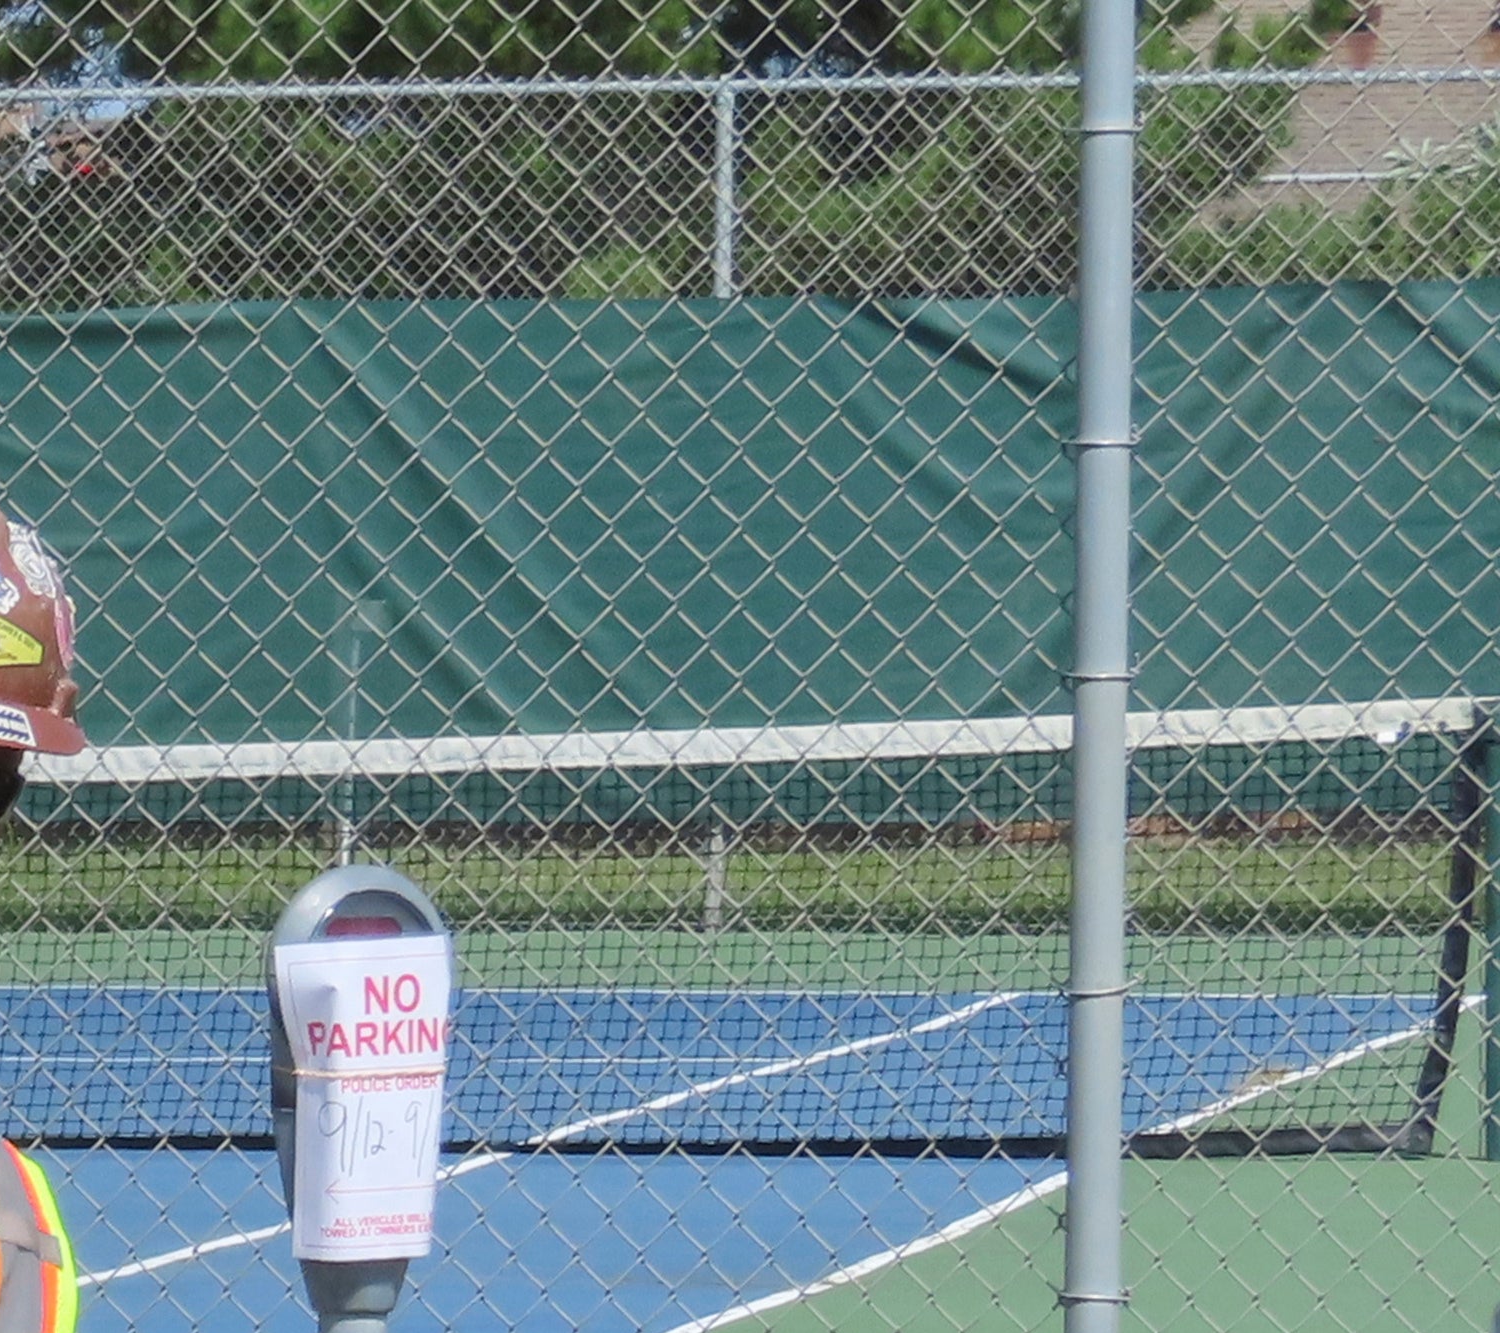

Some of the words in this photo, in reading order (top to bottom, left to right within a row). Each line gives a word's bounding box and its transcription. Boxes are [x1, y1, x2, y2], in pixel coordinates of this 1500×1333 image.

[364, 973, 421, 1015] NO
[341, 1076, 393, 1094] POLICE
[395, 1075, 438, 1091] ORDER
[333, 1218, 353, 1228] ALL
[358, 1214, 405, 1226] VEHICLES
[320, 1226, 357, 1239] TOWED
[359, 1226, 372, 1237] AT
